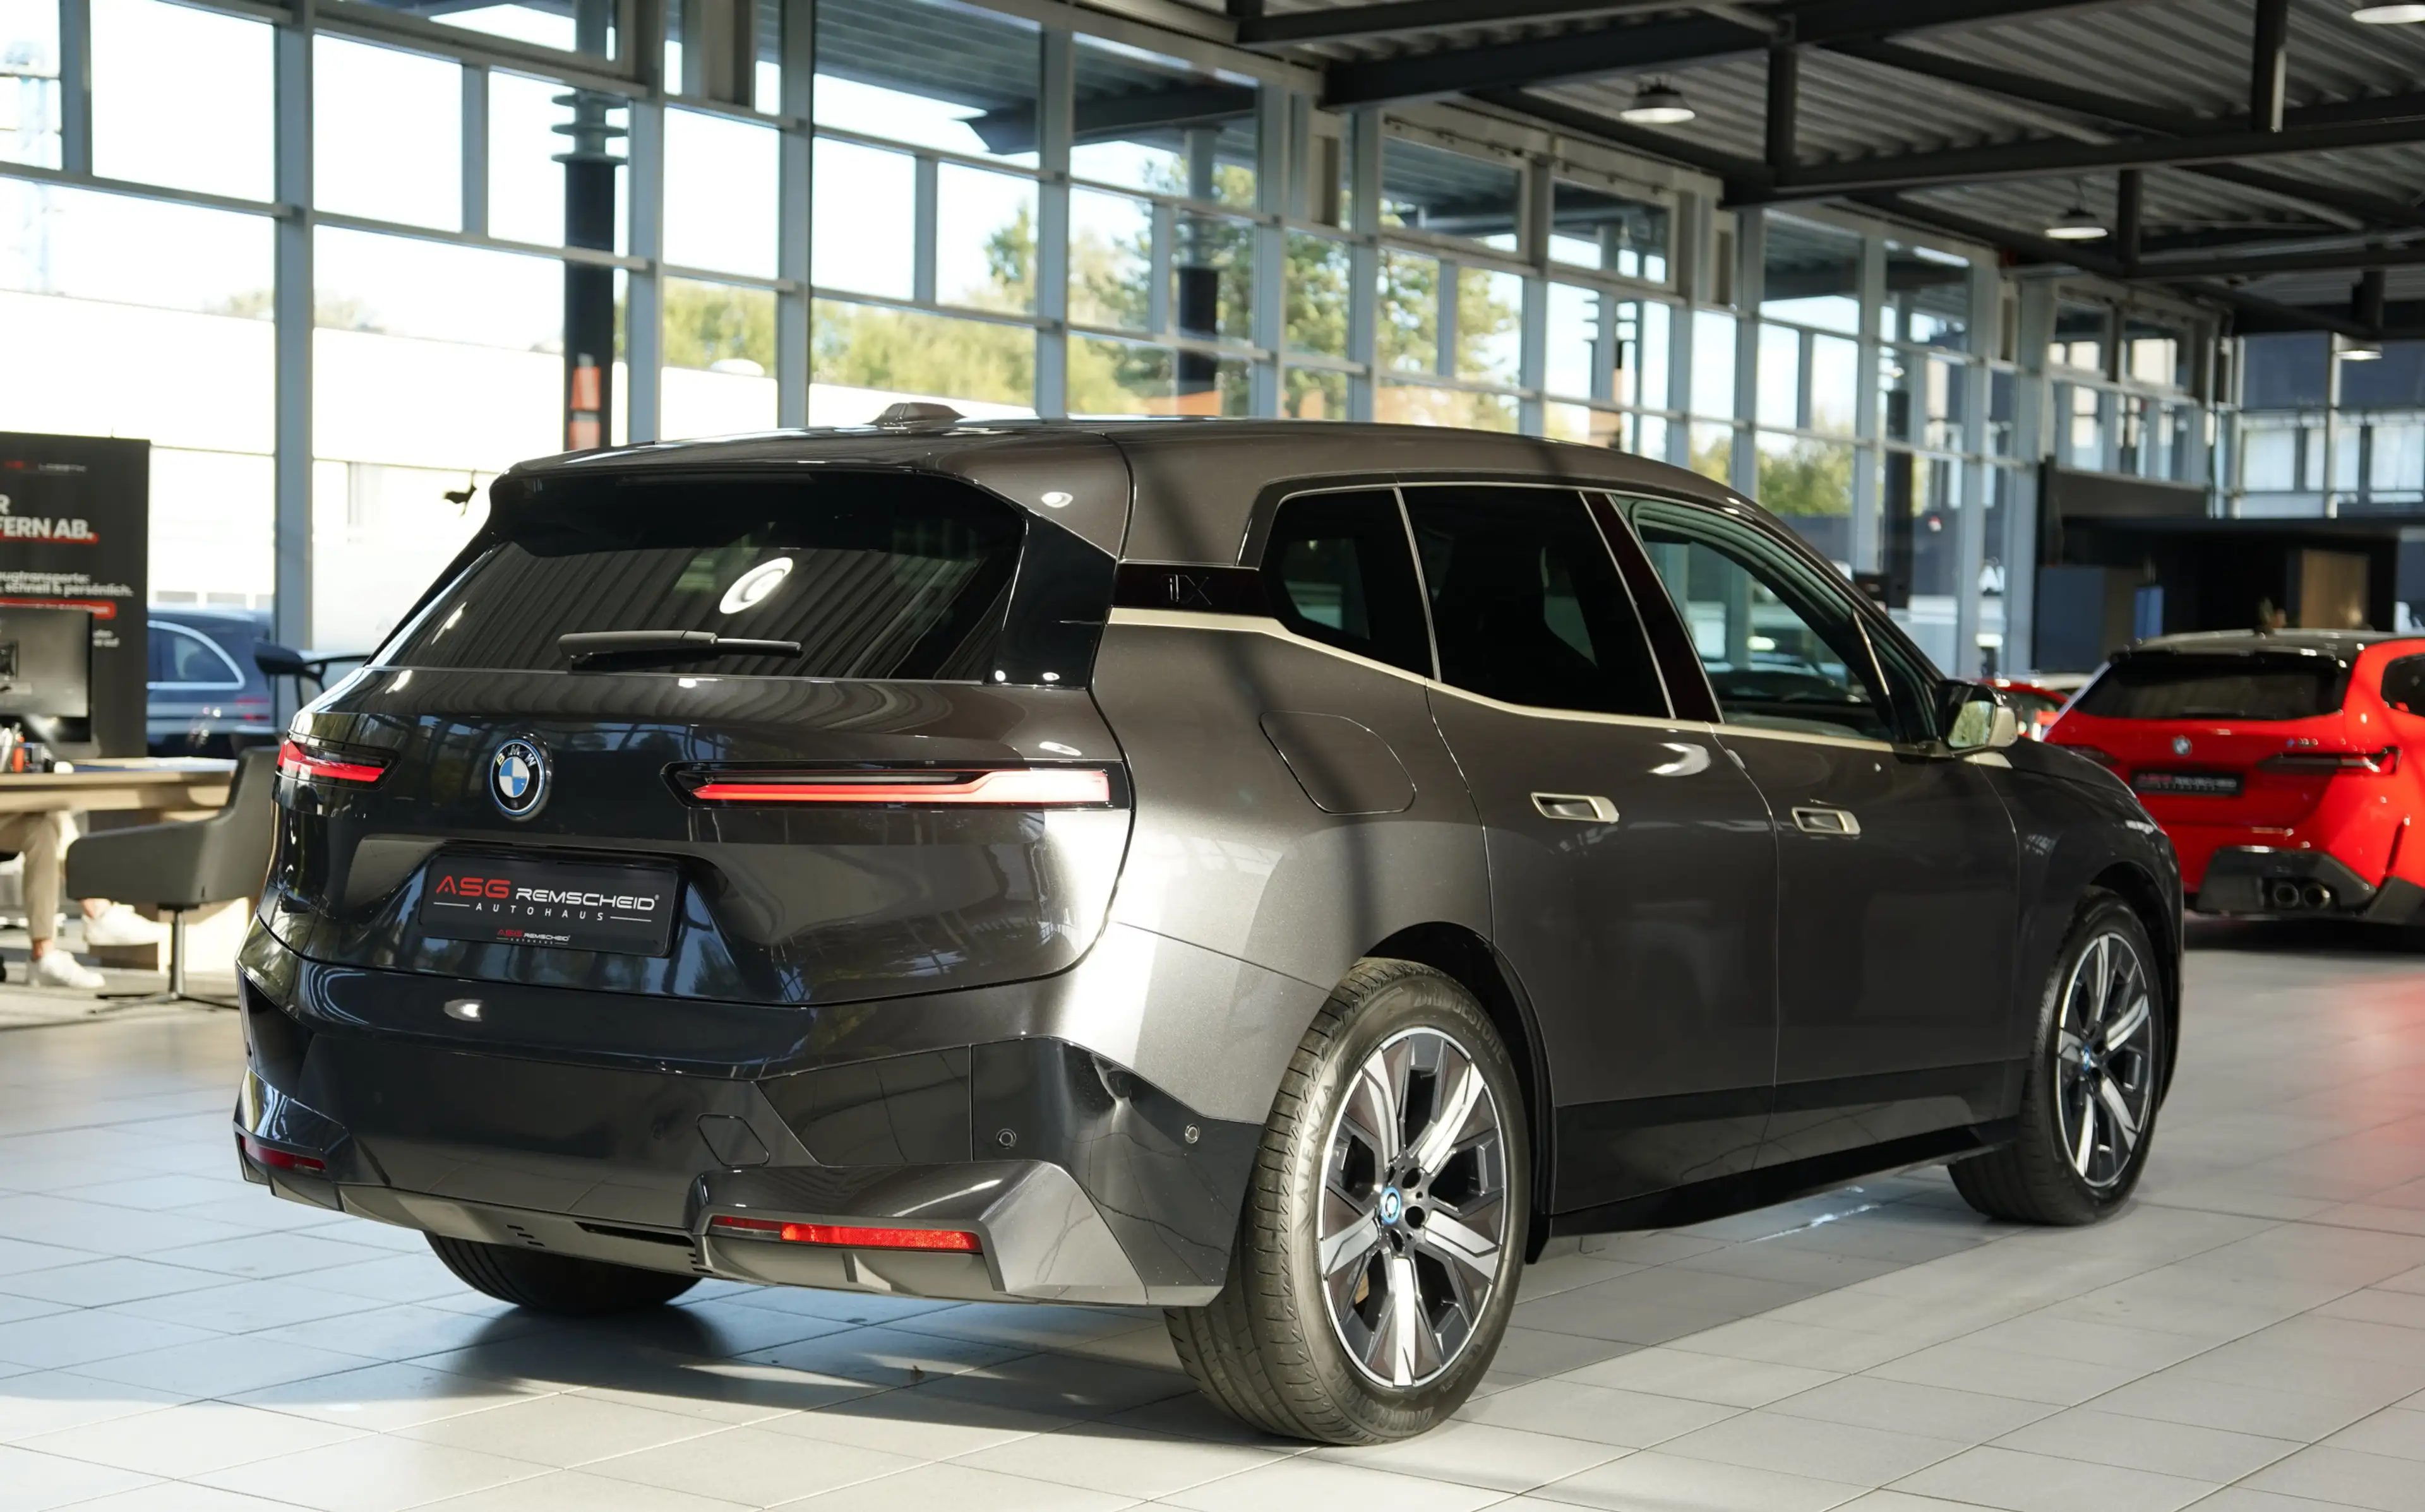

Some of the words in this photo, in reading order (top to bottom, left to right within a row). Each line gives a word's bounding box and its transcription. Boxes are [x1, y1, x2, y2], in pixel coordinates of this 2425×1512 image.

[53, 518, 93, 540] AB.
[496, 745, 536, 767] BMW
[436, 876, 511, 898] ASG
[476, 902, 604, 921] AUTOHAUS
[497, 929, 523, 937] ASG
[1296, 1085, 1333, 1204] ALENZA
